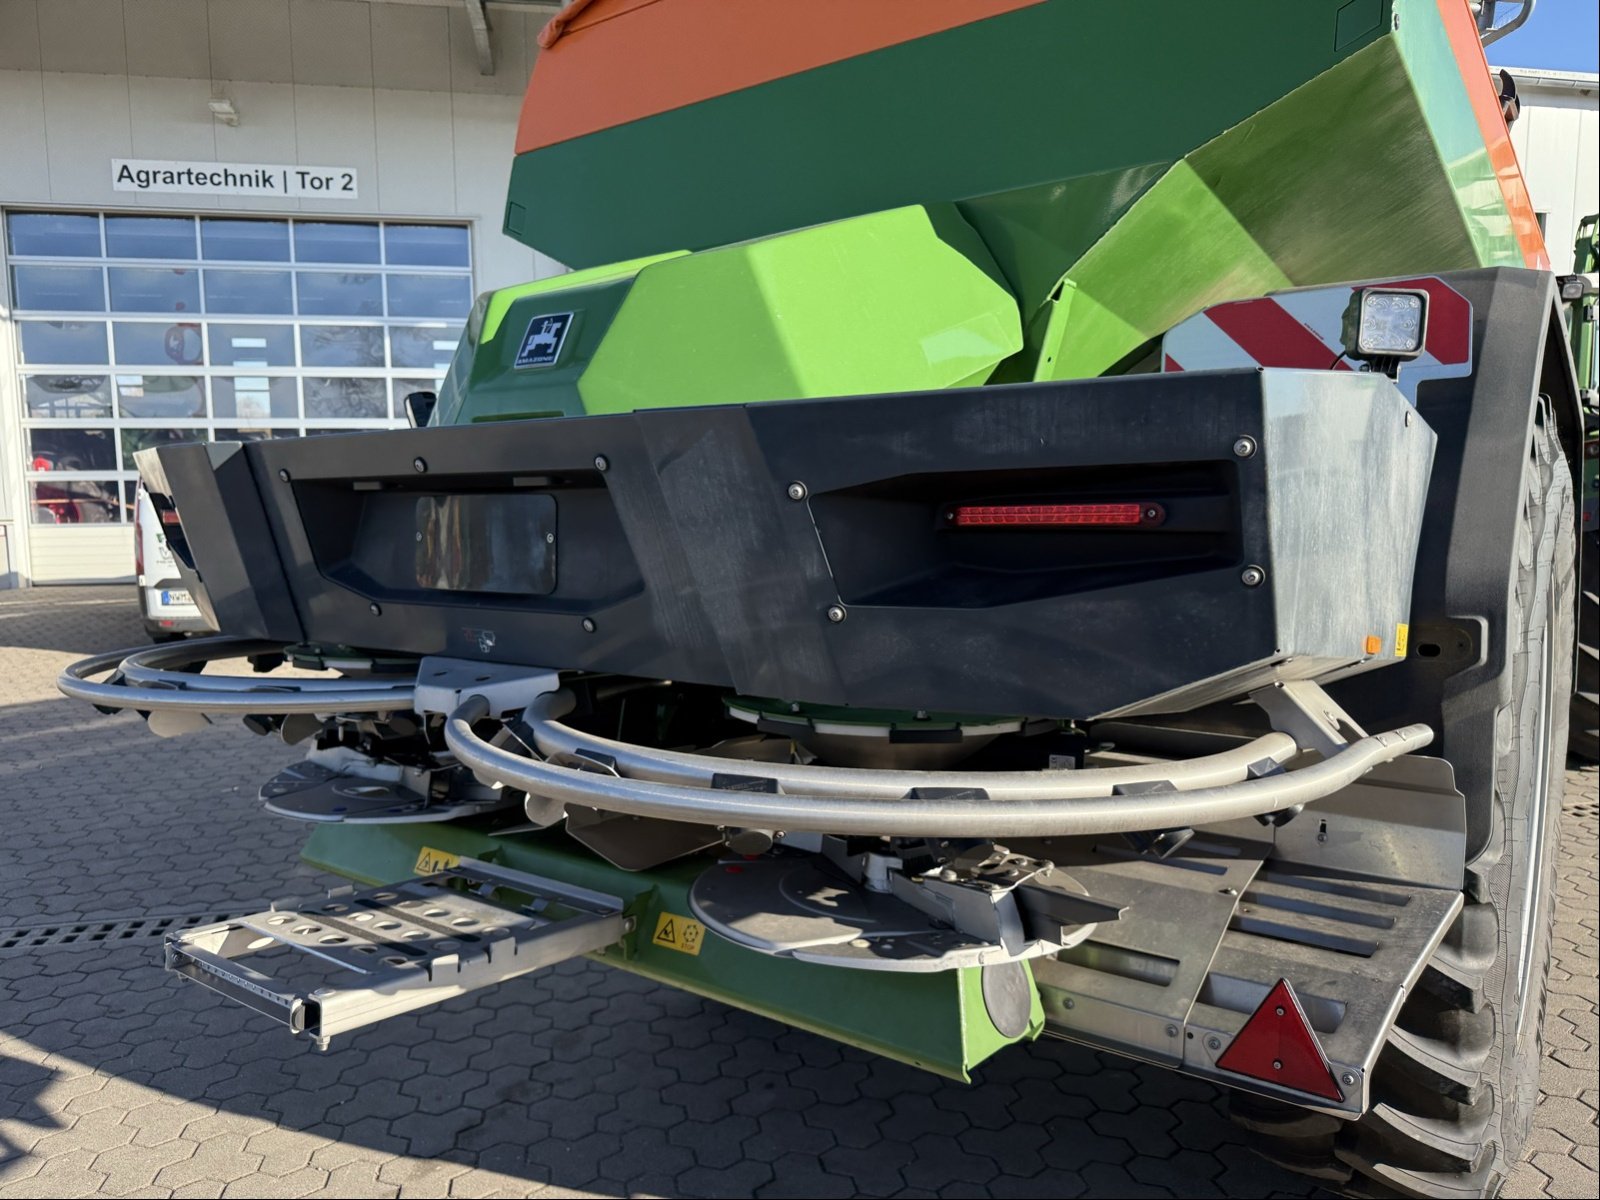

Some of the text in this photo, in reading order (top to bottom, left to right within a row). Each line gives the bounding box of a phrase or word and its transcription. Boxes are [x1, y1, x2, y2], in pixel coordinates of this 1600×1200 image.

[117, 164, 275, 189] Agrartechnik
[295, 171, 334, 190] Tor
[341, 173, 354, 191] 2
